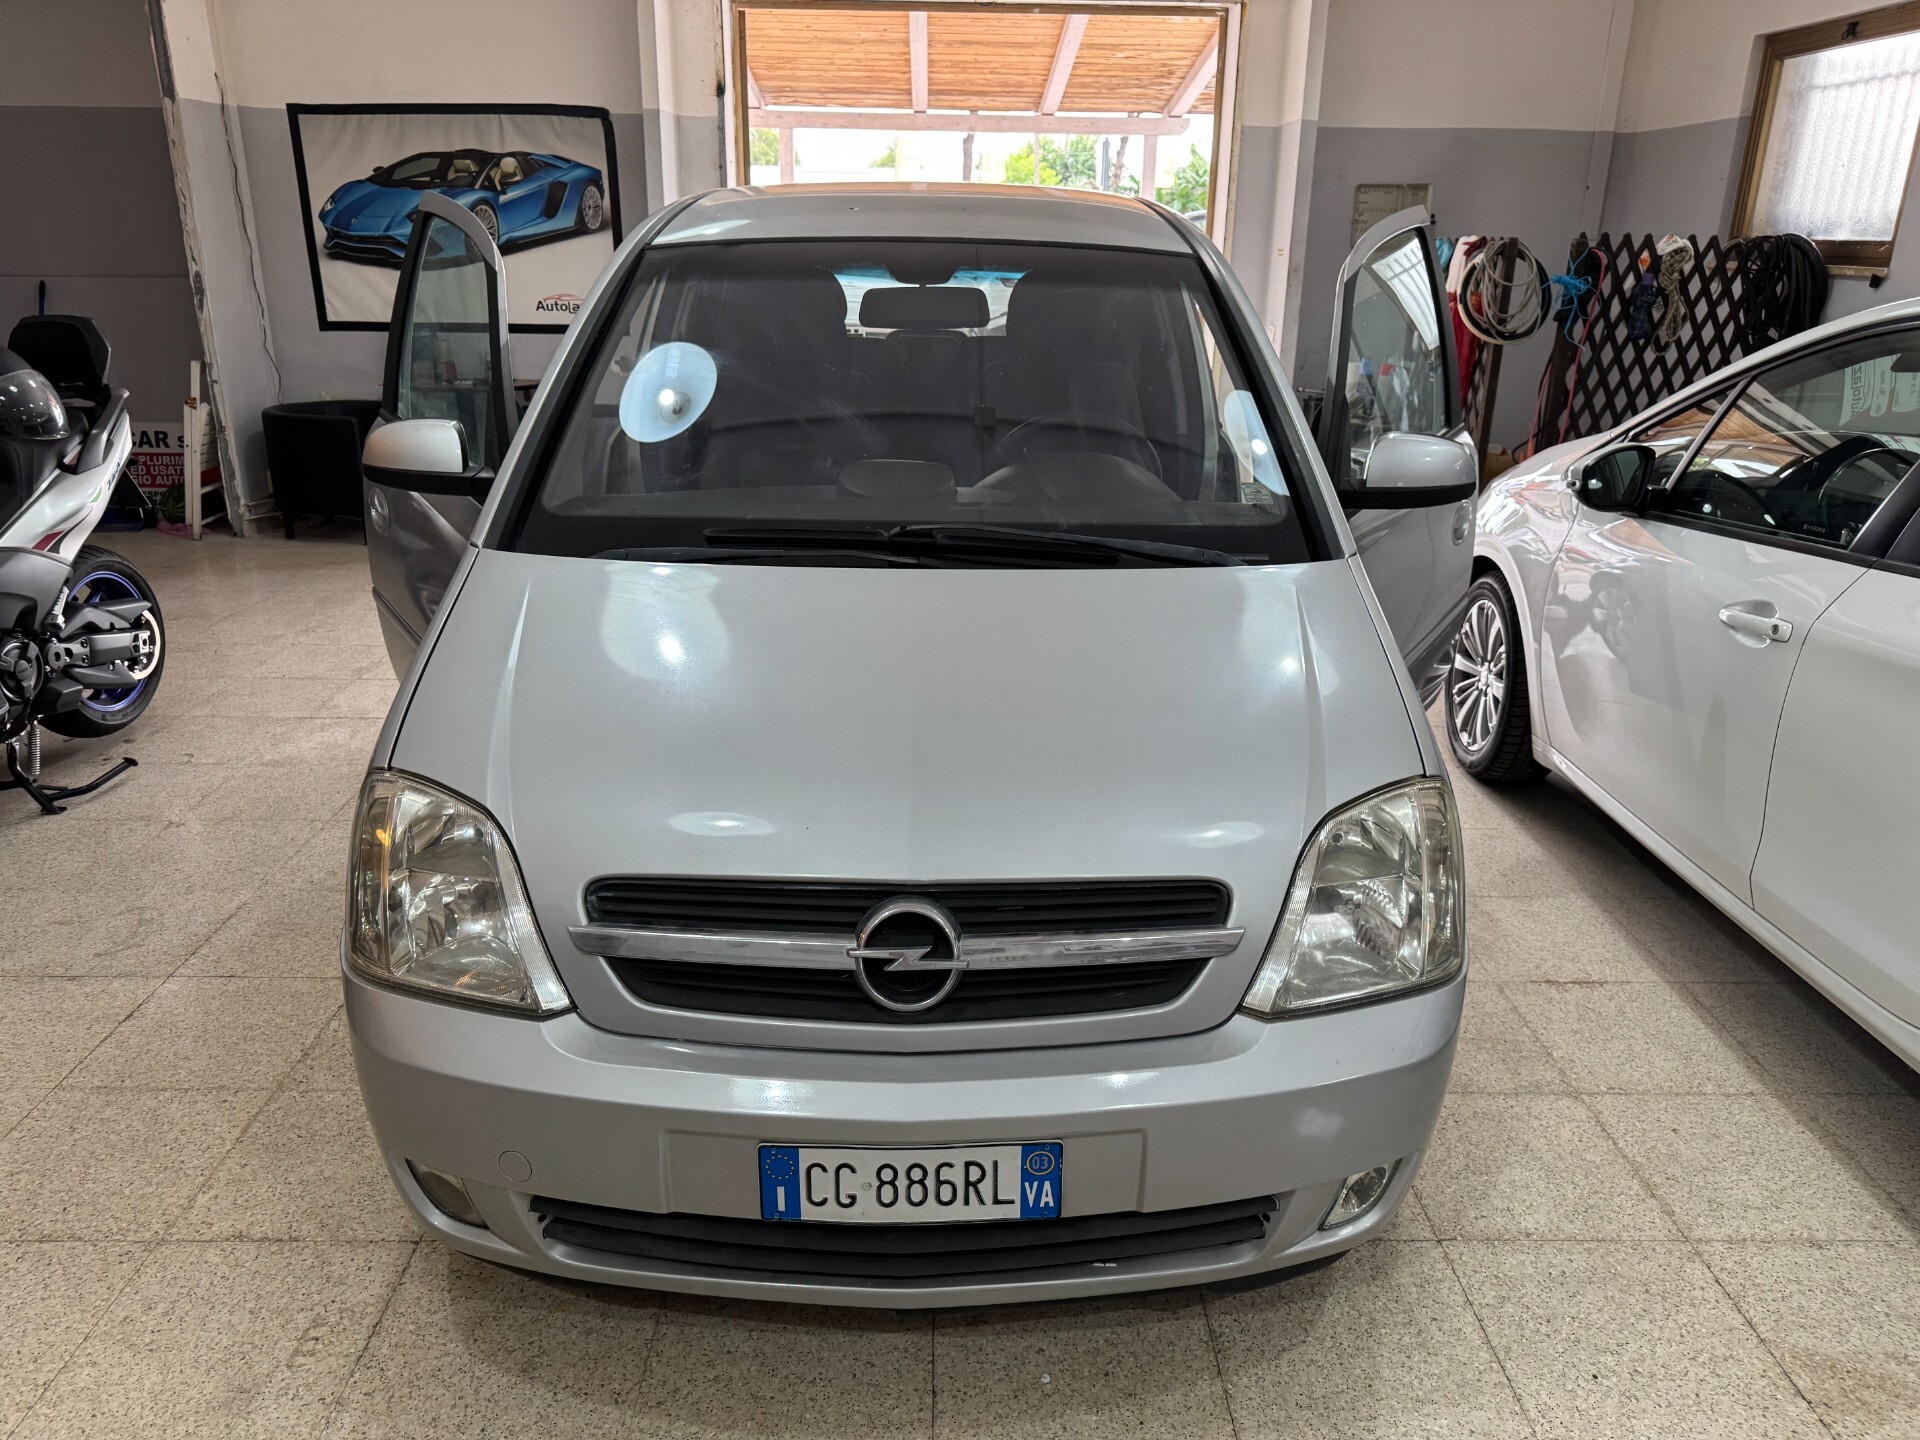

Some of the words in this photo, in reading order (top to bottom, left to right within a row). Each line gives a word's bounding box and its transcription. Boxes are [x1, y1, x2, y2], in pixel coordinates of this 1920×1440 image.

[131, 430, 170, 448] AR
[804, 1162, 858, 1209] CG
[875, 1159, 1016, 1209] 886RL
[1023, 1180, 1055, 1208] VA
[776, 1186, 786, 1212] I
